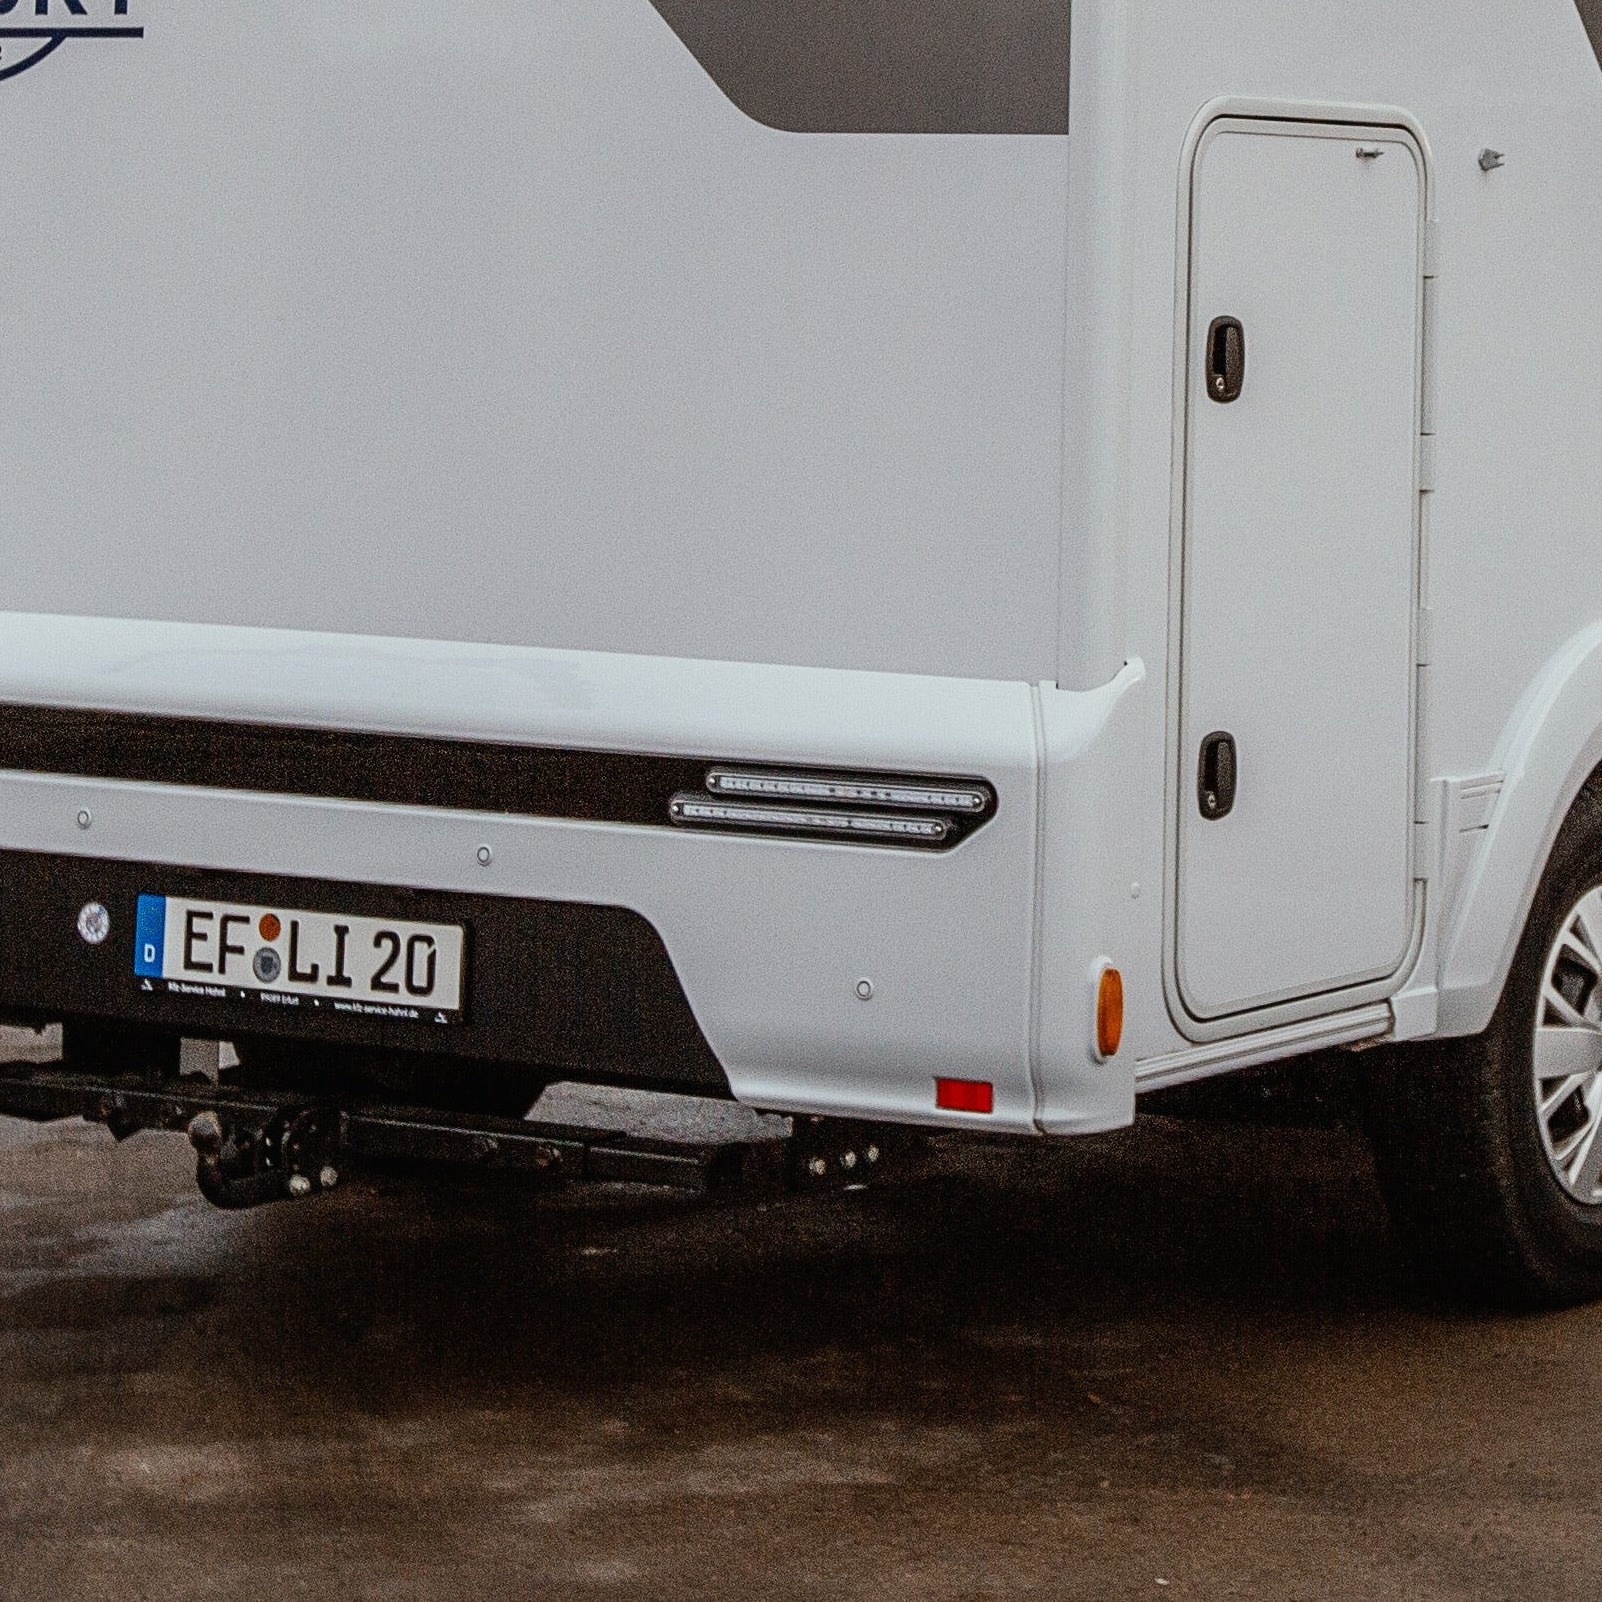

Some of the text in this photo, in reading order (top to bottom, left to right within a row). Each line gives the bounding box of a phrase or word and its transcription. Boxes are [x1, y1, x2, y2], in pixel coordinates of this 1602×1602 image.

[144, 909, 436, 996] D EF LI 20
